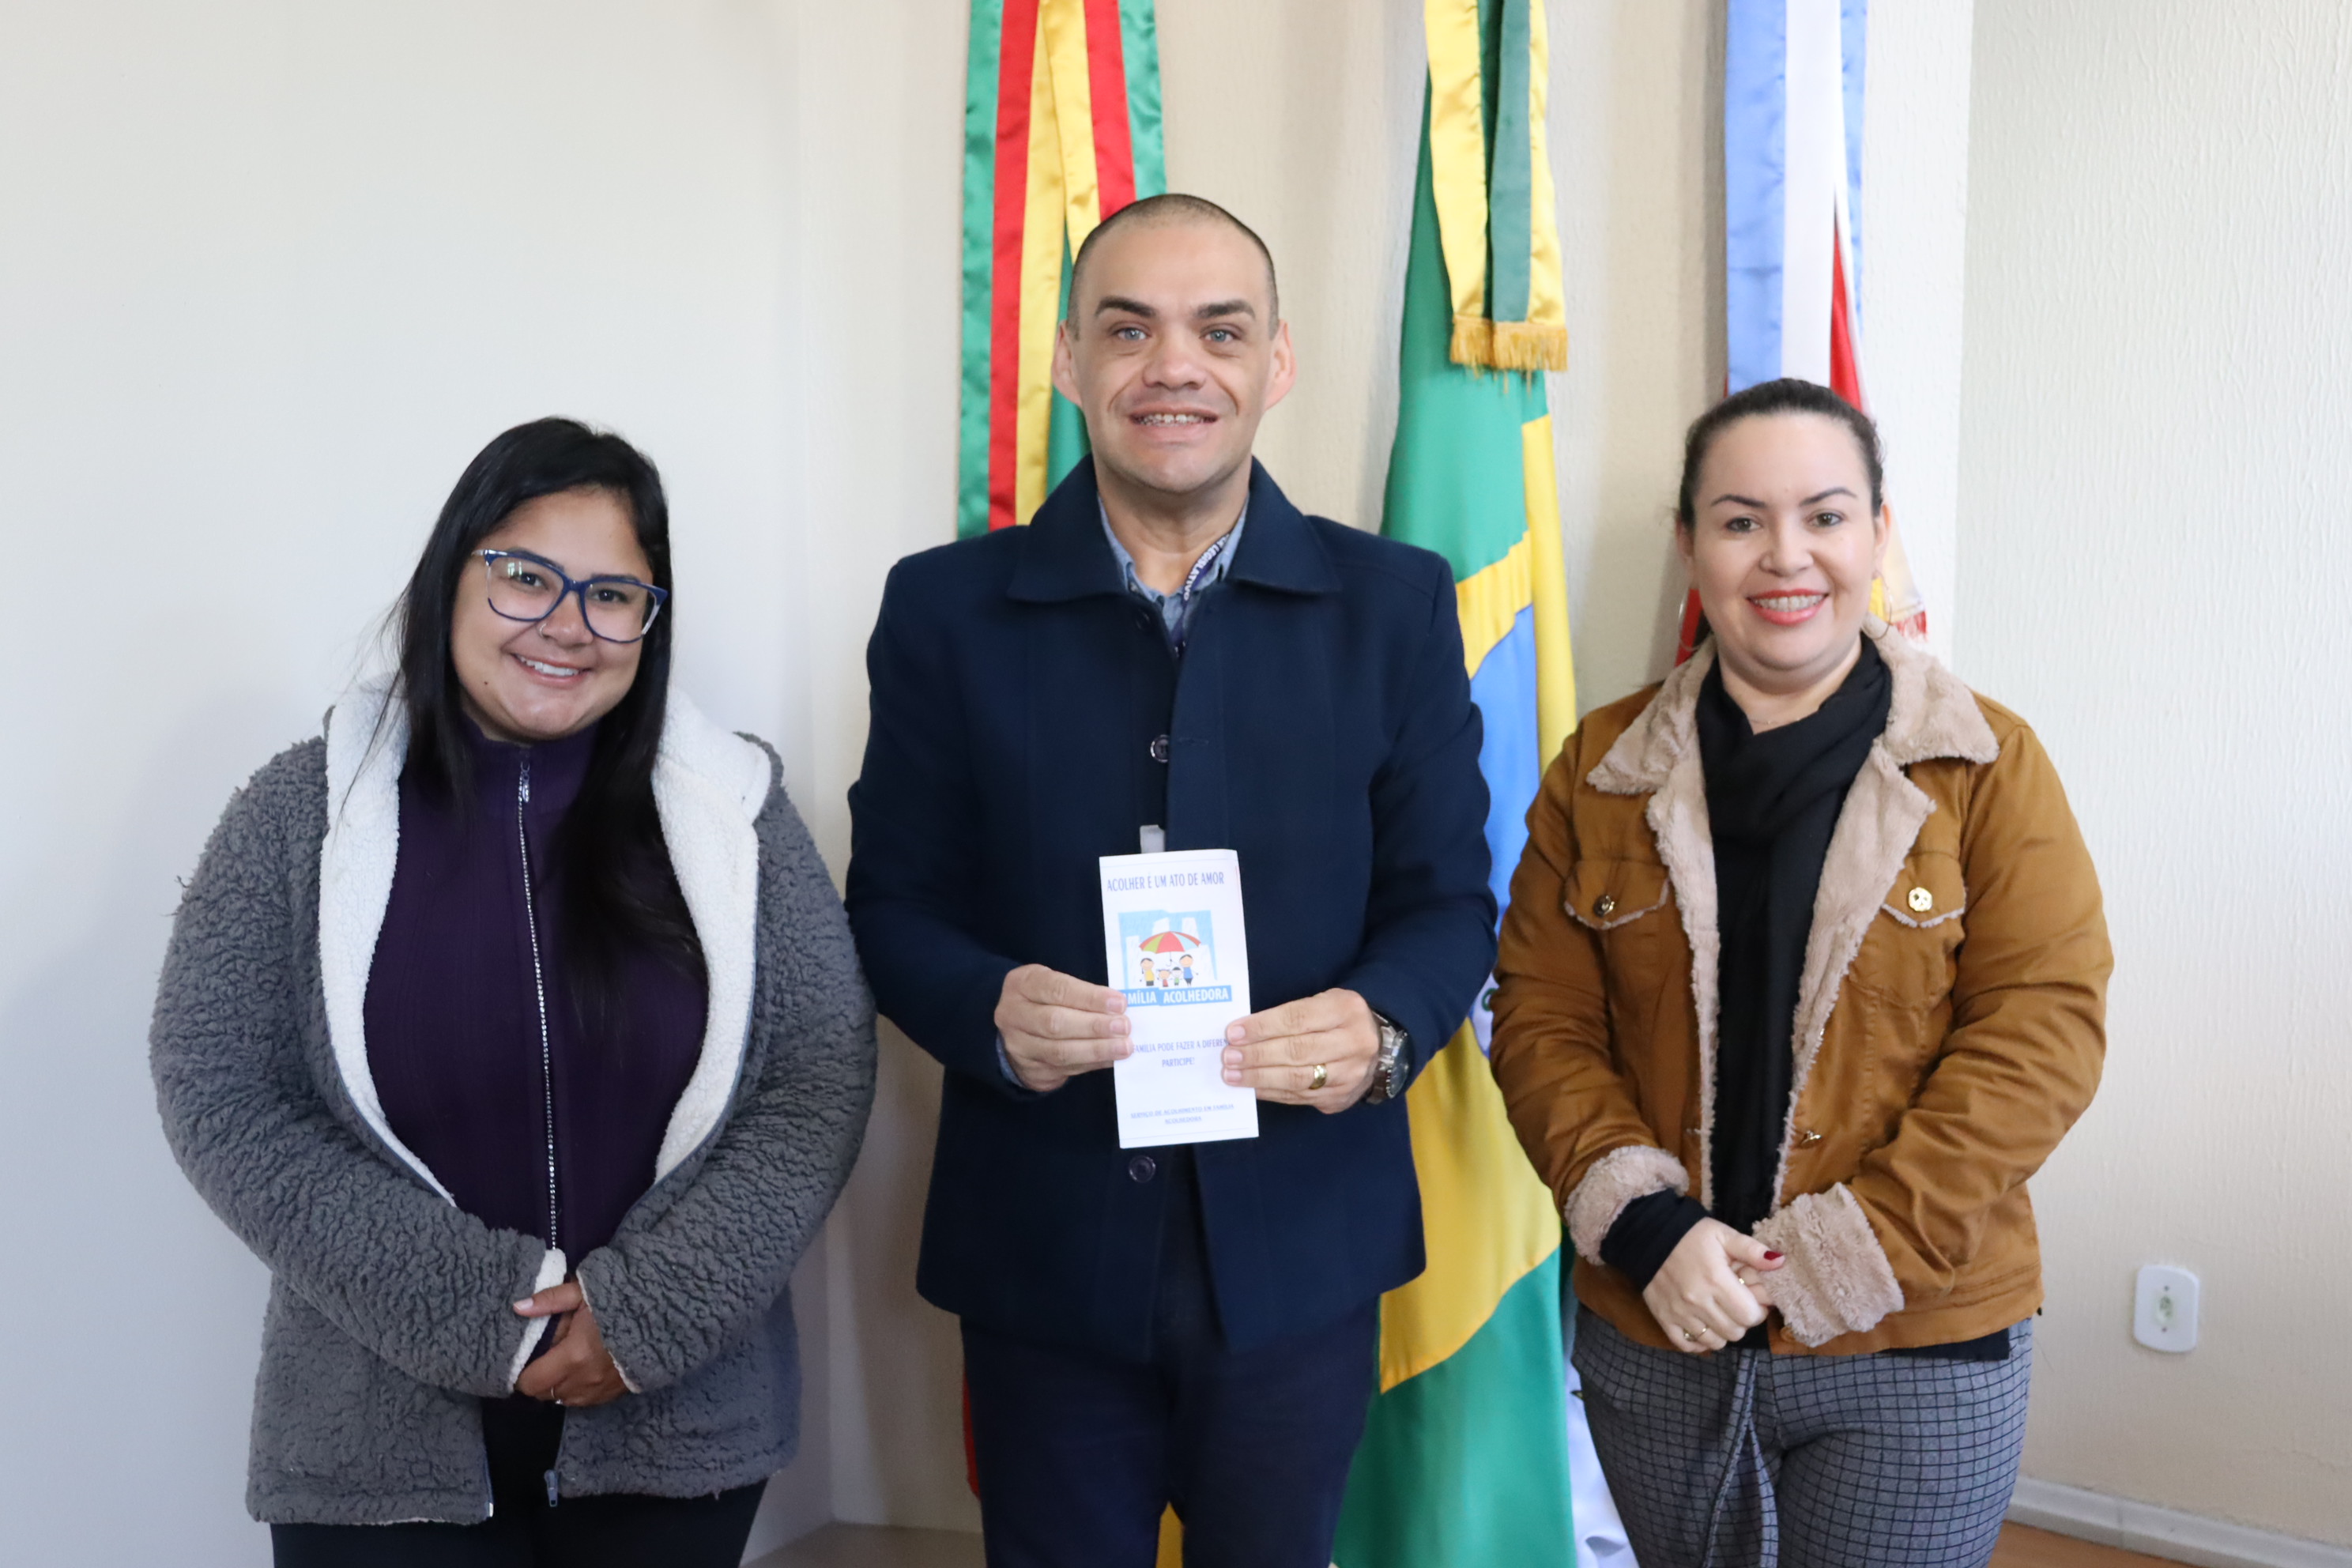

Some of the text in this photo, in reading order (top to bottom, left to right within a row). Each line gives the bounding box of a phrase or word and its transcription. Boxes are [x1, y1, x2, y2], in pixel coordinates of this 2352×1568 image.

[1107, 876, 1145, 891] ACOLHER
[1155, 874, 1167, 888] UM
[1170, 873, 1185, 888] ATO
[1188, 873, 1199, 886] DE
[1201, 872, 1224, 885] AMOR
[1125, 987, 1229, 1004] MÍLIA ACOLHEDORA
[1157, 1043, 1174, 1052] PODE
[1176, 1041, 1195, 1050] FAZER
